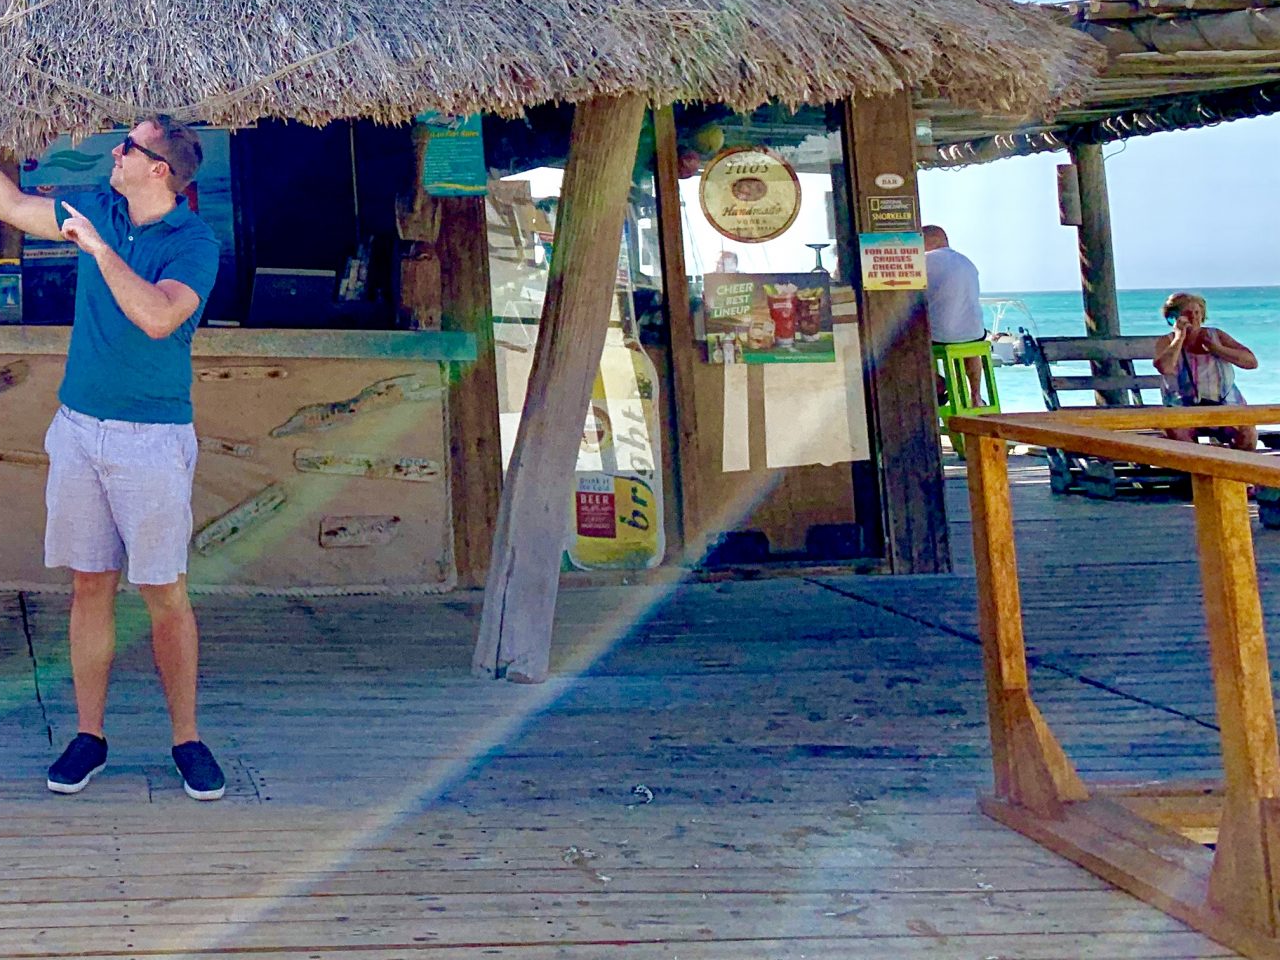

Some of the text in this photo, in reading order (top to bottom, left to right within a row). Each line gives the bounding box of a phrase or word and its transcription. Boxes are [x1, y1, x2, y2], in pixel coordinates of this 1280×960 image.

[872, 212, 912, 221] SNORKELER
[900, 247, 919, 255] OUR
[872, 255, 913, 263] CRUISES
[872, 263, 902, 271] CHECK
[868, 270, 922, 279] AT THE DESK
[716, 281, 754, 295] CHEER
[713, 305, 751, 318] LINEUP
[580, 493, 610, 505] BEER
